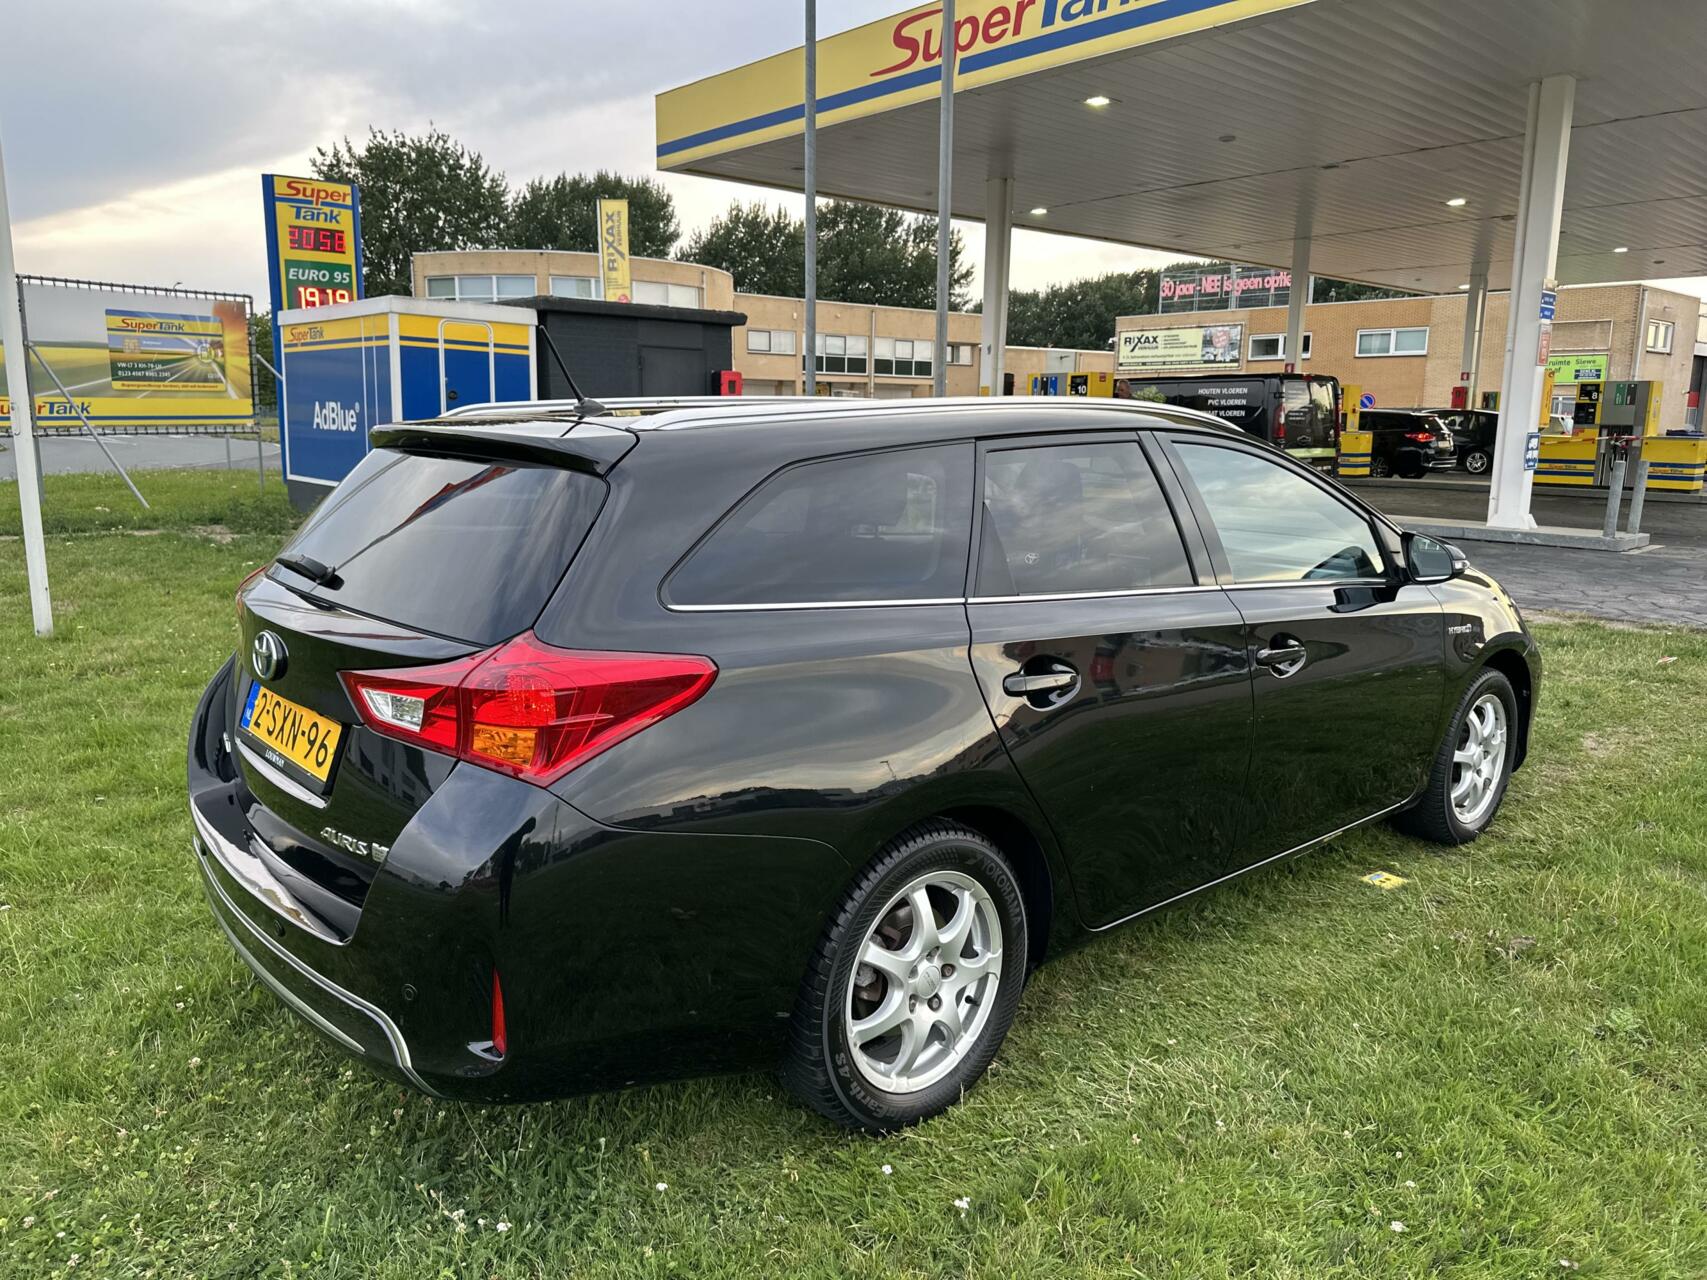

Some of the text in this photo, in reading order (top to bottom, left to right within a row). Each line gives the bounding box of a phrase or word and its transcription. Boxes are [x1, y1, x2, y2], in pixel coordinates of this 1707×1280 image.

[276, 181, 351, 206] Super
[288, 206, 342, 224] Tank
[289, 268, 350, 283] EURO 95
[116, 318, 186, 334] SuperTank
[1124, 333, 1159, 352] RIXAX
[1077, 385, 1087, 394] 10
[1591, 392, 1598, 400] 8
[1220, 398, 1247, 406] VLOEREN
[253, 692, 332, 768] 2-SXN-96
[320, 827, 369, 857] AURIS
[981, 855, 1022, 929] YOKOHAMA
